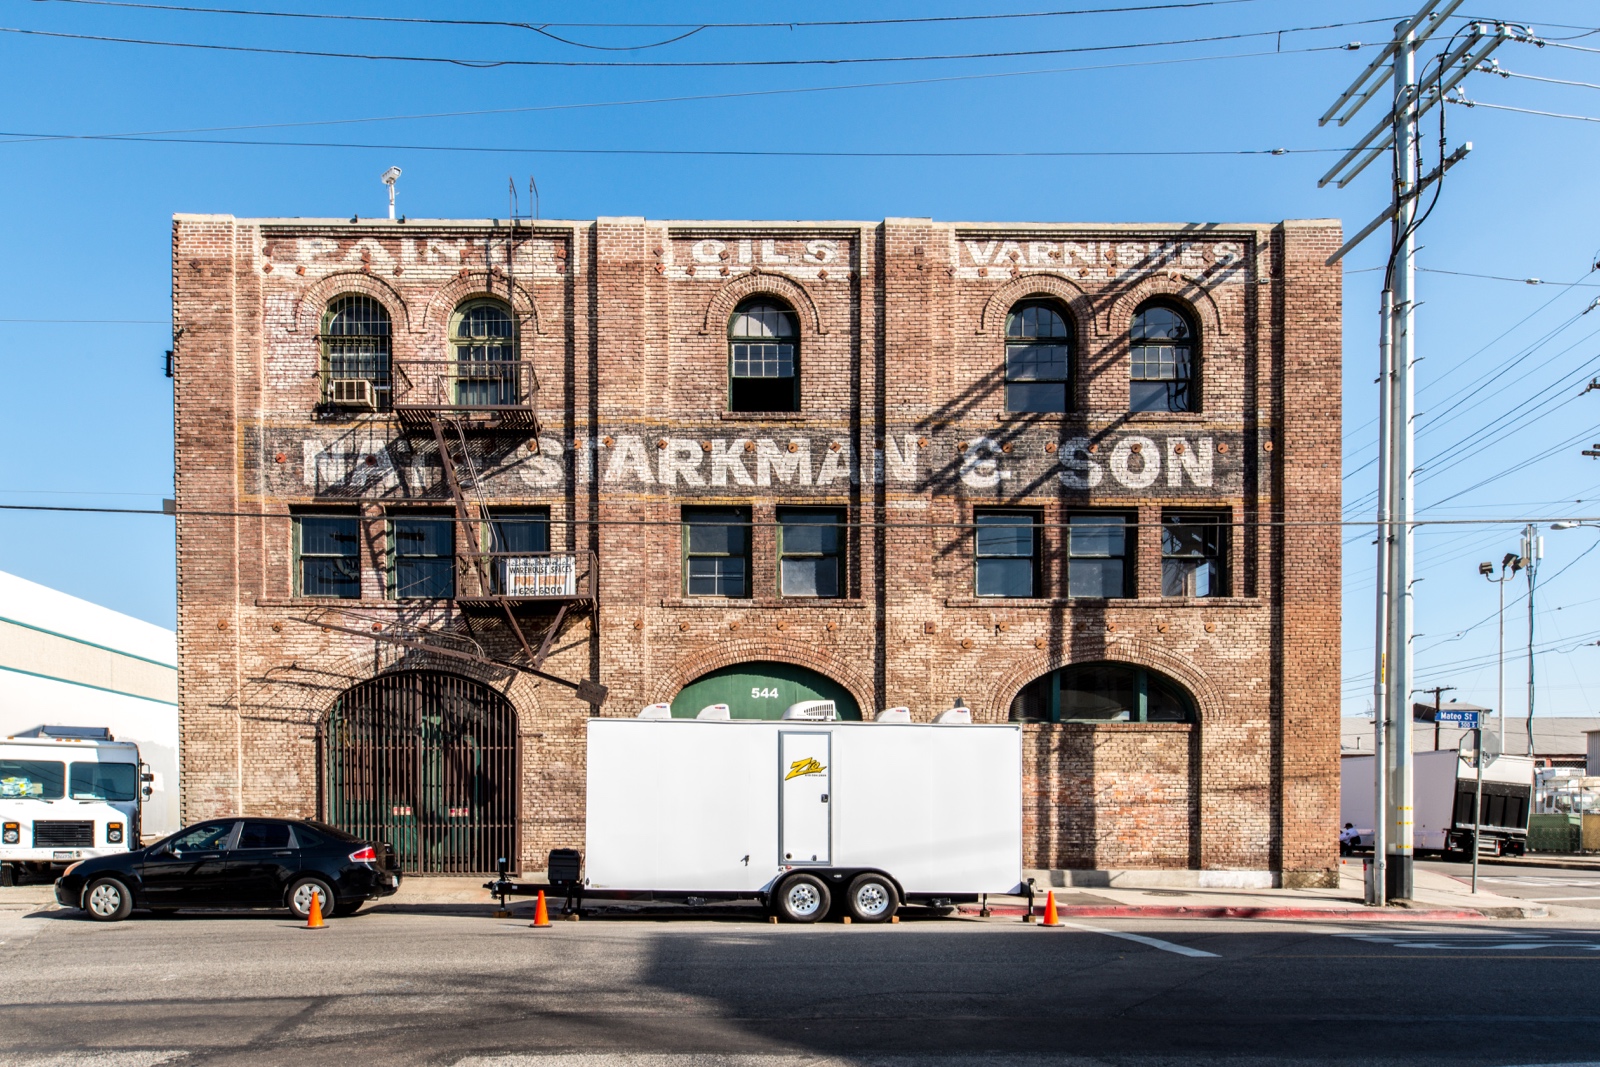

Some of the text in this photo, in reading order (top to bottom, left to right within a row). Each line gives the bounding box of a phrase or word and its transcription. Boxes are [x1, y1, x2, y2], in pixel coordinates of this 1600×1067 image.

[691, 239, 839, 263] OILS
[965, 240, 1242, 266] VARNISHES
[516, 435, 918, 487] STARKMAN
[959, 437, 1011, 488] &
[1059, 437, 1214, 489] SON
[509, 566, 548, 574] WAREHOUSE
[751, 687, 779, 699] 544
